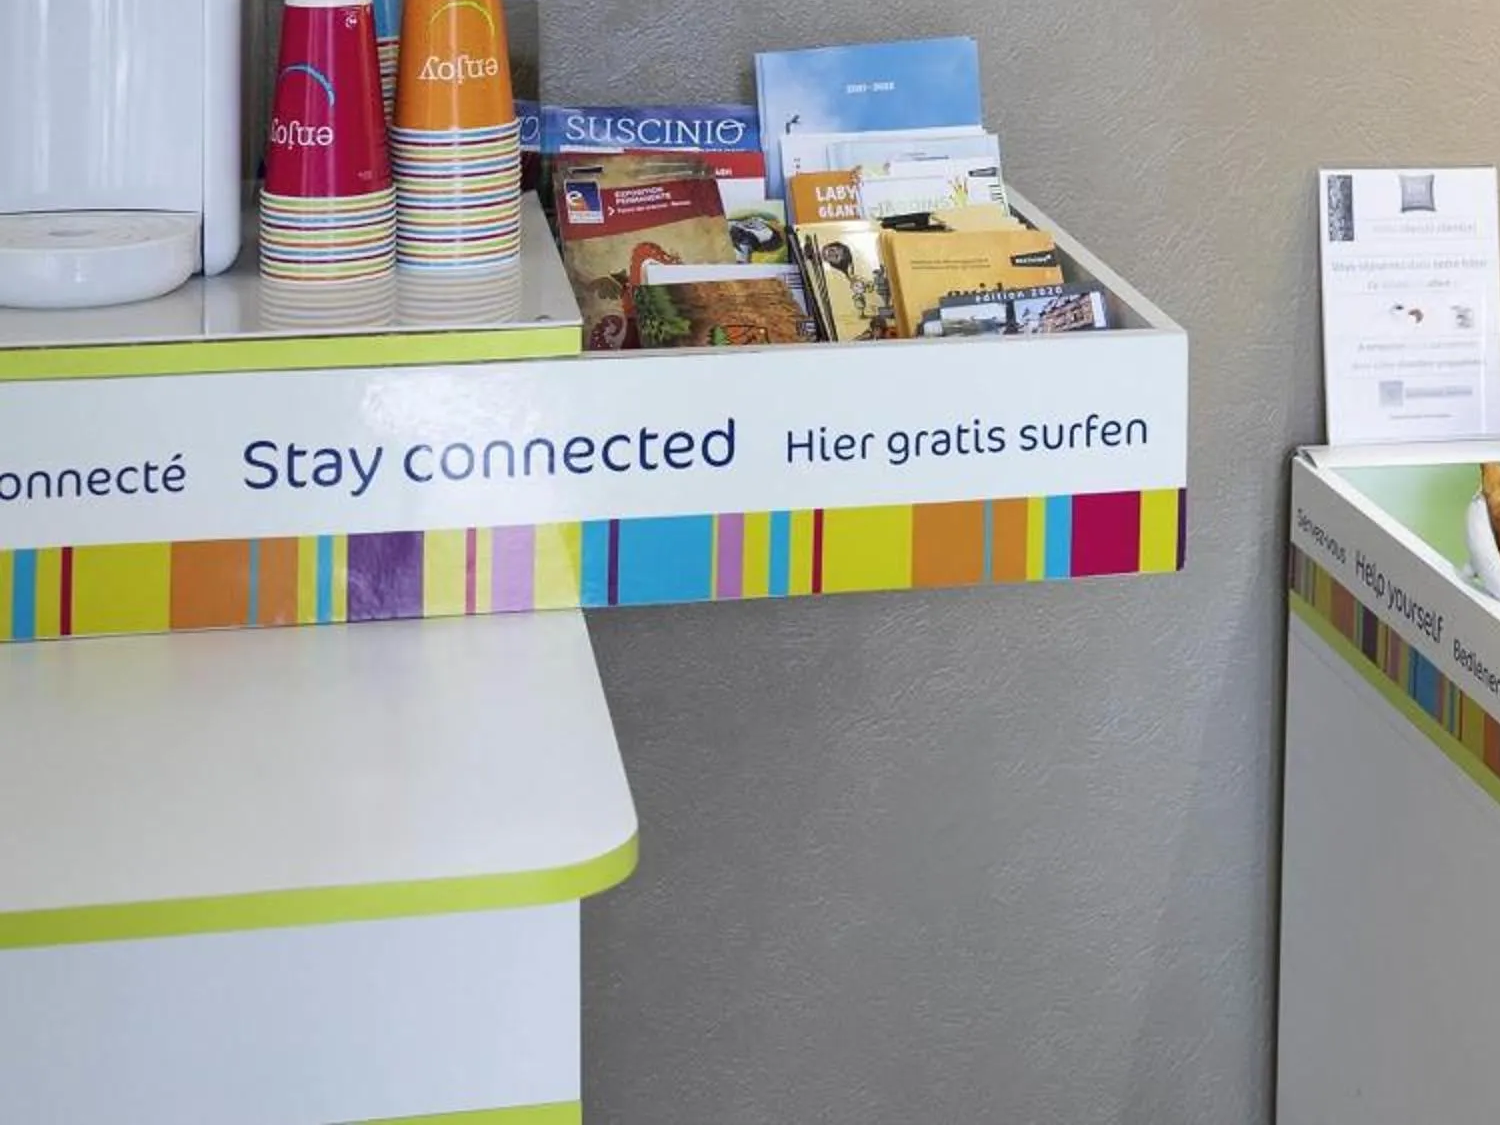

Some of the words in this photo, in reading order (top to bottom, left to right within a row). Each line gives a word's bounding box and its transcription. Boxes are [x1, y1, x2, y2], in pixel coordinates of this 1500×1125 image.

[418, 55, 500, 86] enjoy
[566, 114, 747, 145] SUSCINIO
[0, 452, 187, 501] onnecté
[243, 439, 383, 497] Stay
[403, 417, 737, 484] connected
[786, 425, 874, 464] Hier
[886, 418, 1006, 466] gratis
[1018, 413, 1148, 451] surfen
[1355, 548, 1386, 600] Help
[1387, 579, 1445, 644] yourself
